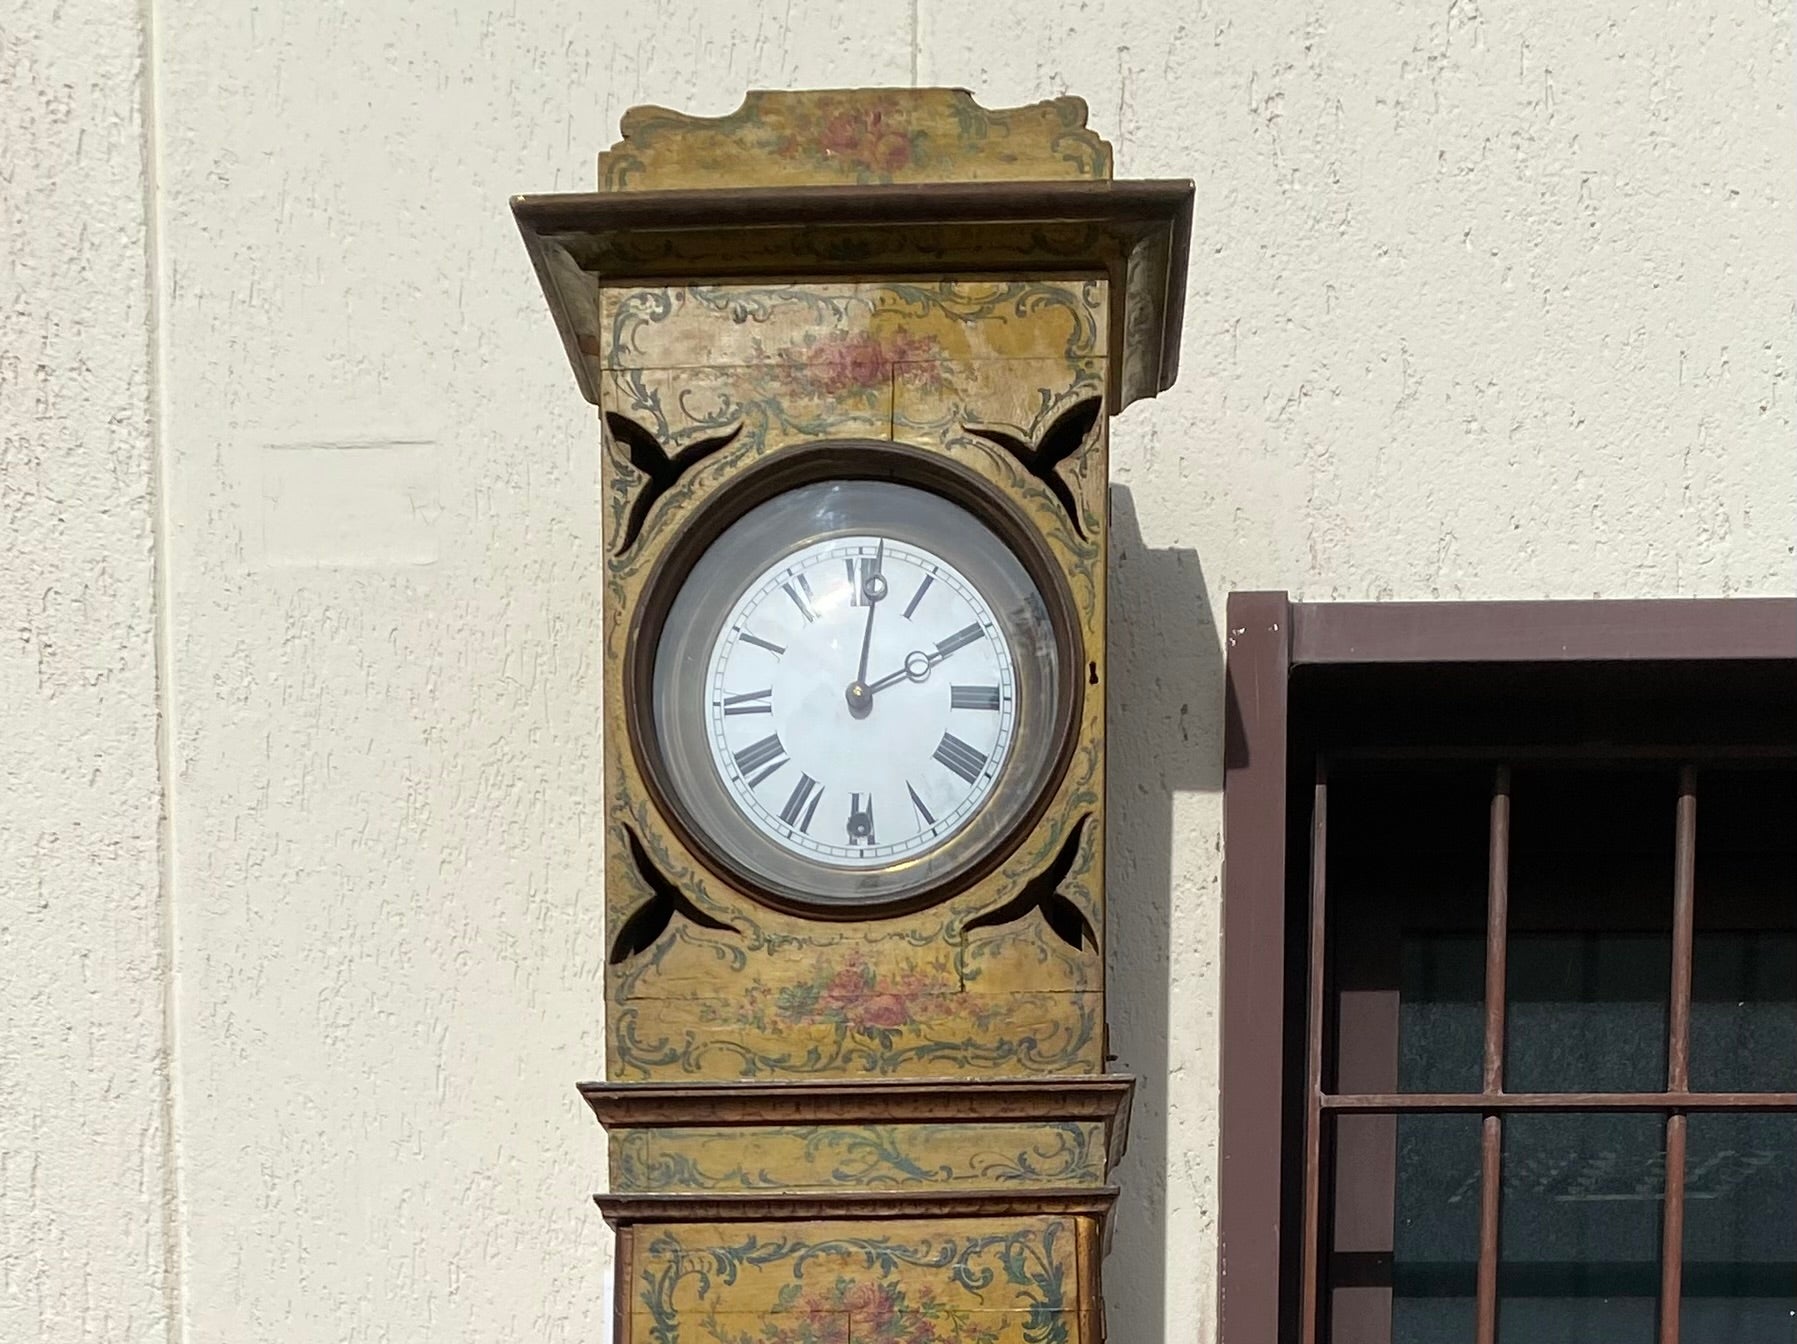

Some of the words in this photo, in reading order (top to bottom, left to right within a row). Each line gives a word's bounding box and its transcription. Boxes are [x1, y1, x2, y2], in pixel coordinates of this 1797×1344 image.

[900, 573, 937, 622] I
[933, 621, 988, 660] II
[723, 683, 774, 717] IX
[949, 682, 1001, 714] III
[731, 729, 792, 794] VIII
[930, 728, 990, 788] IIII
[776, 769, 826, 836] VII
[905, 779, 938, 833] V
